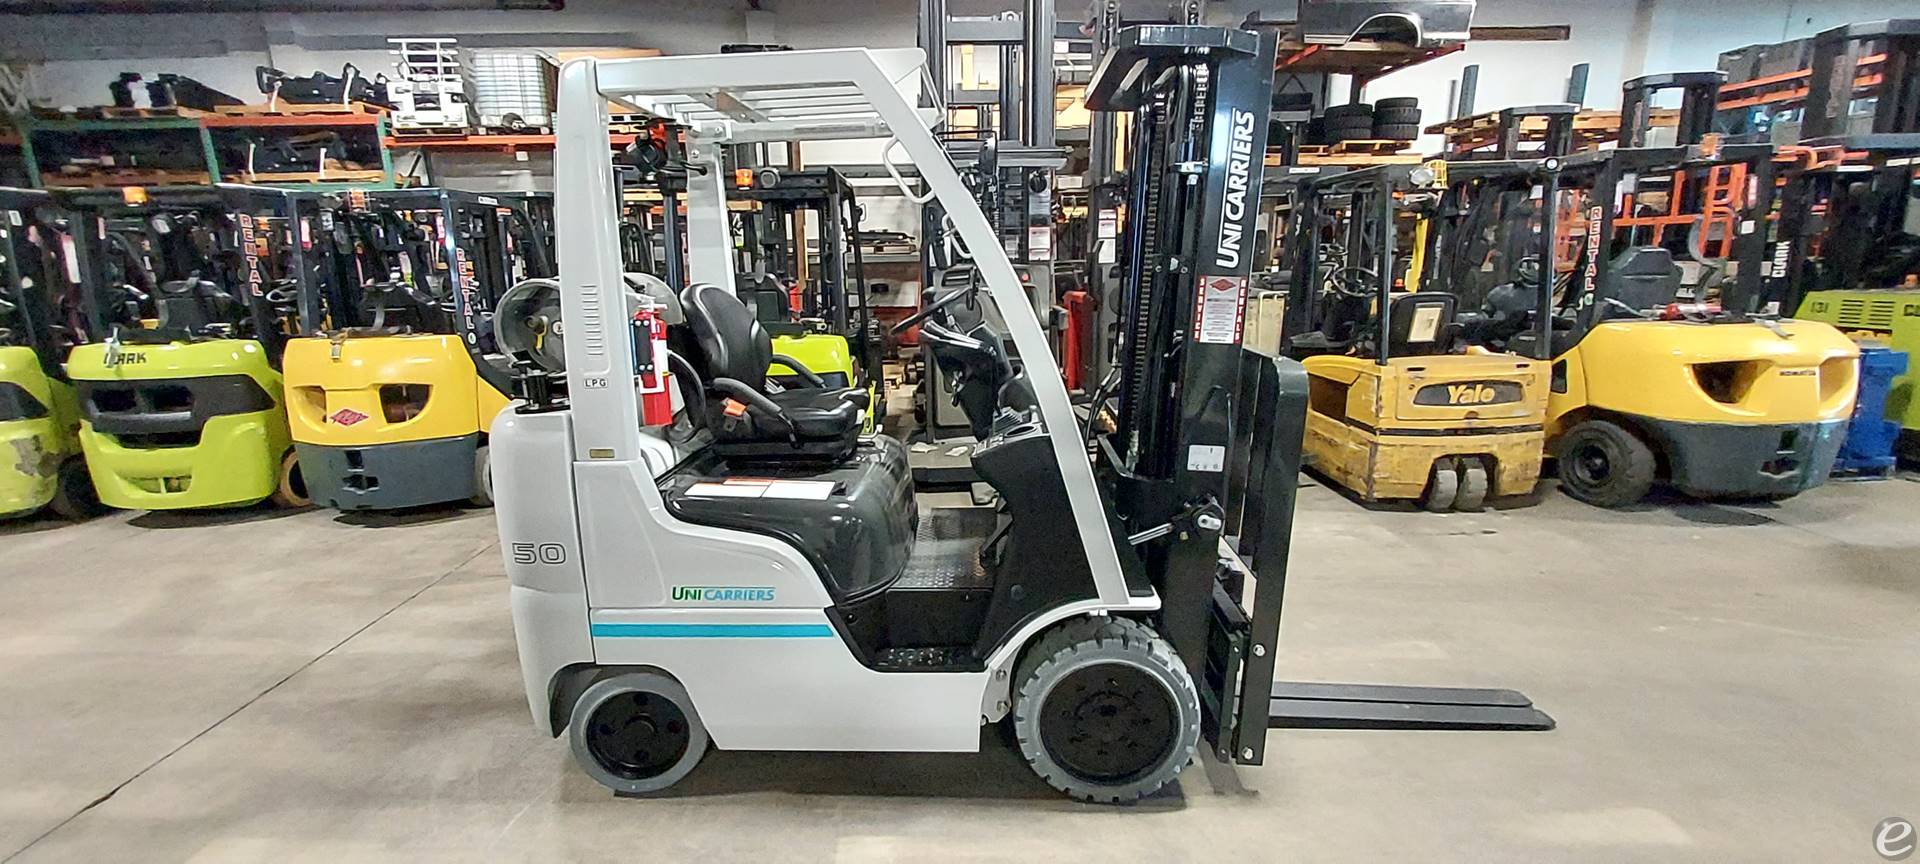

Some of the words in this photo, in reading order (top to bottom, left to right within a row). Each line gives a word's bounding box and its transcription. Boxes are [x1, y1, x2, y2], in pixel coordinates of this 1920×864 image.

[239, 213, 264, 297] RENTAL
[1584, 205, 1603, 291] RENTAL
[1771, 240, 1791, 278] CLARK
[456, 247, 475, 330] RENTAL
[1194, 278, 1205, 339] SERVICE
[1235, 279, 1247, 341] RENTALS
[1810, 302, 1830, 314] 131
[585, 378, 606, 387] LPG
[1447, 384, 1496, 404] Yale
[511, 542, 567, 565] 50
